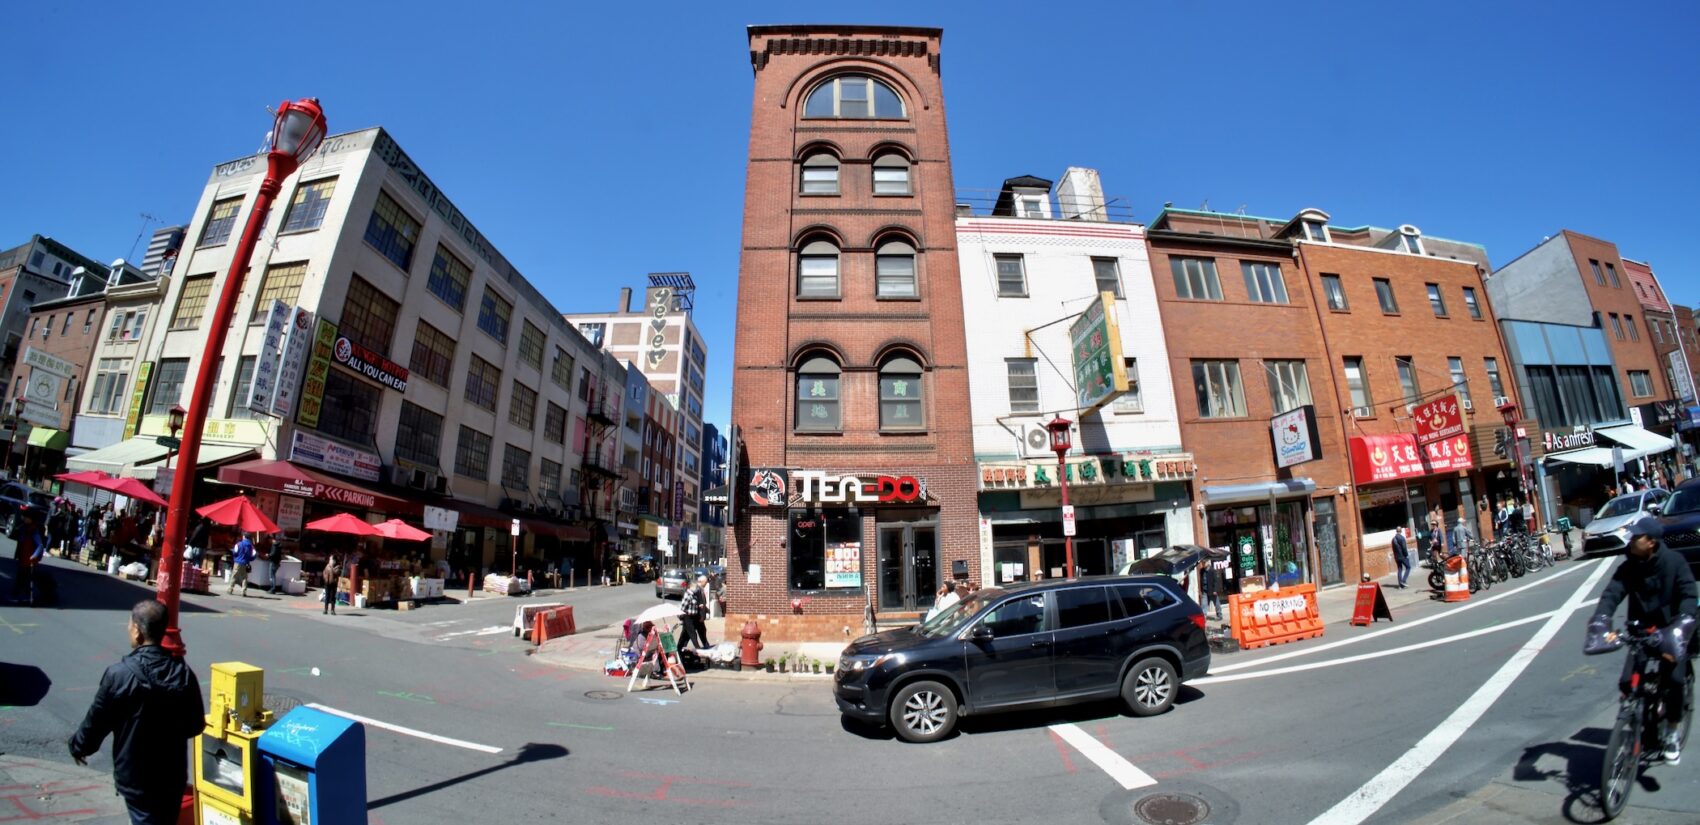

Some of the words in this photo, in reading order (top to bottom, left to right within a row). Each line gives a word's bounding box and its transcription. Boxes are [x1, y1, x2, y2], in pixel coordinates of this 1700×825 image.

[347, 356, 362, 371] ALL
[362, 362, 380, 379] YOU
[378, 371, 395, 387] CAN
[393, 378, 408, 392] EAT
[315, 484, 324, 496] P
[343, 490, 375, 506] PARKING
[792, 470, 920, 502] TEA-DO
[1259, 602, 1269, 612] NO
[1272, 598, 1304, 611] PARKING
